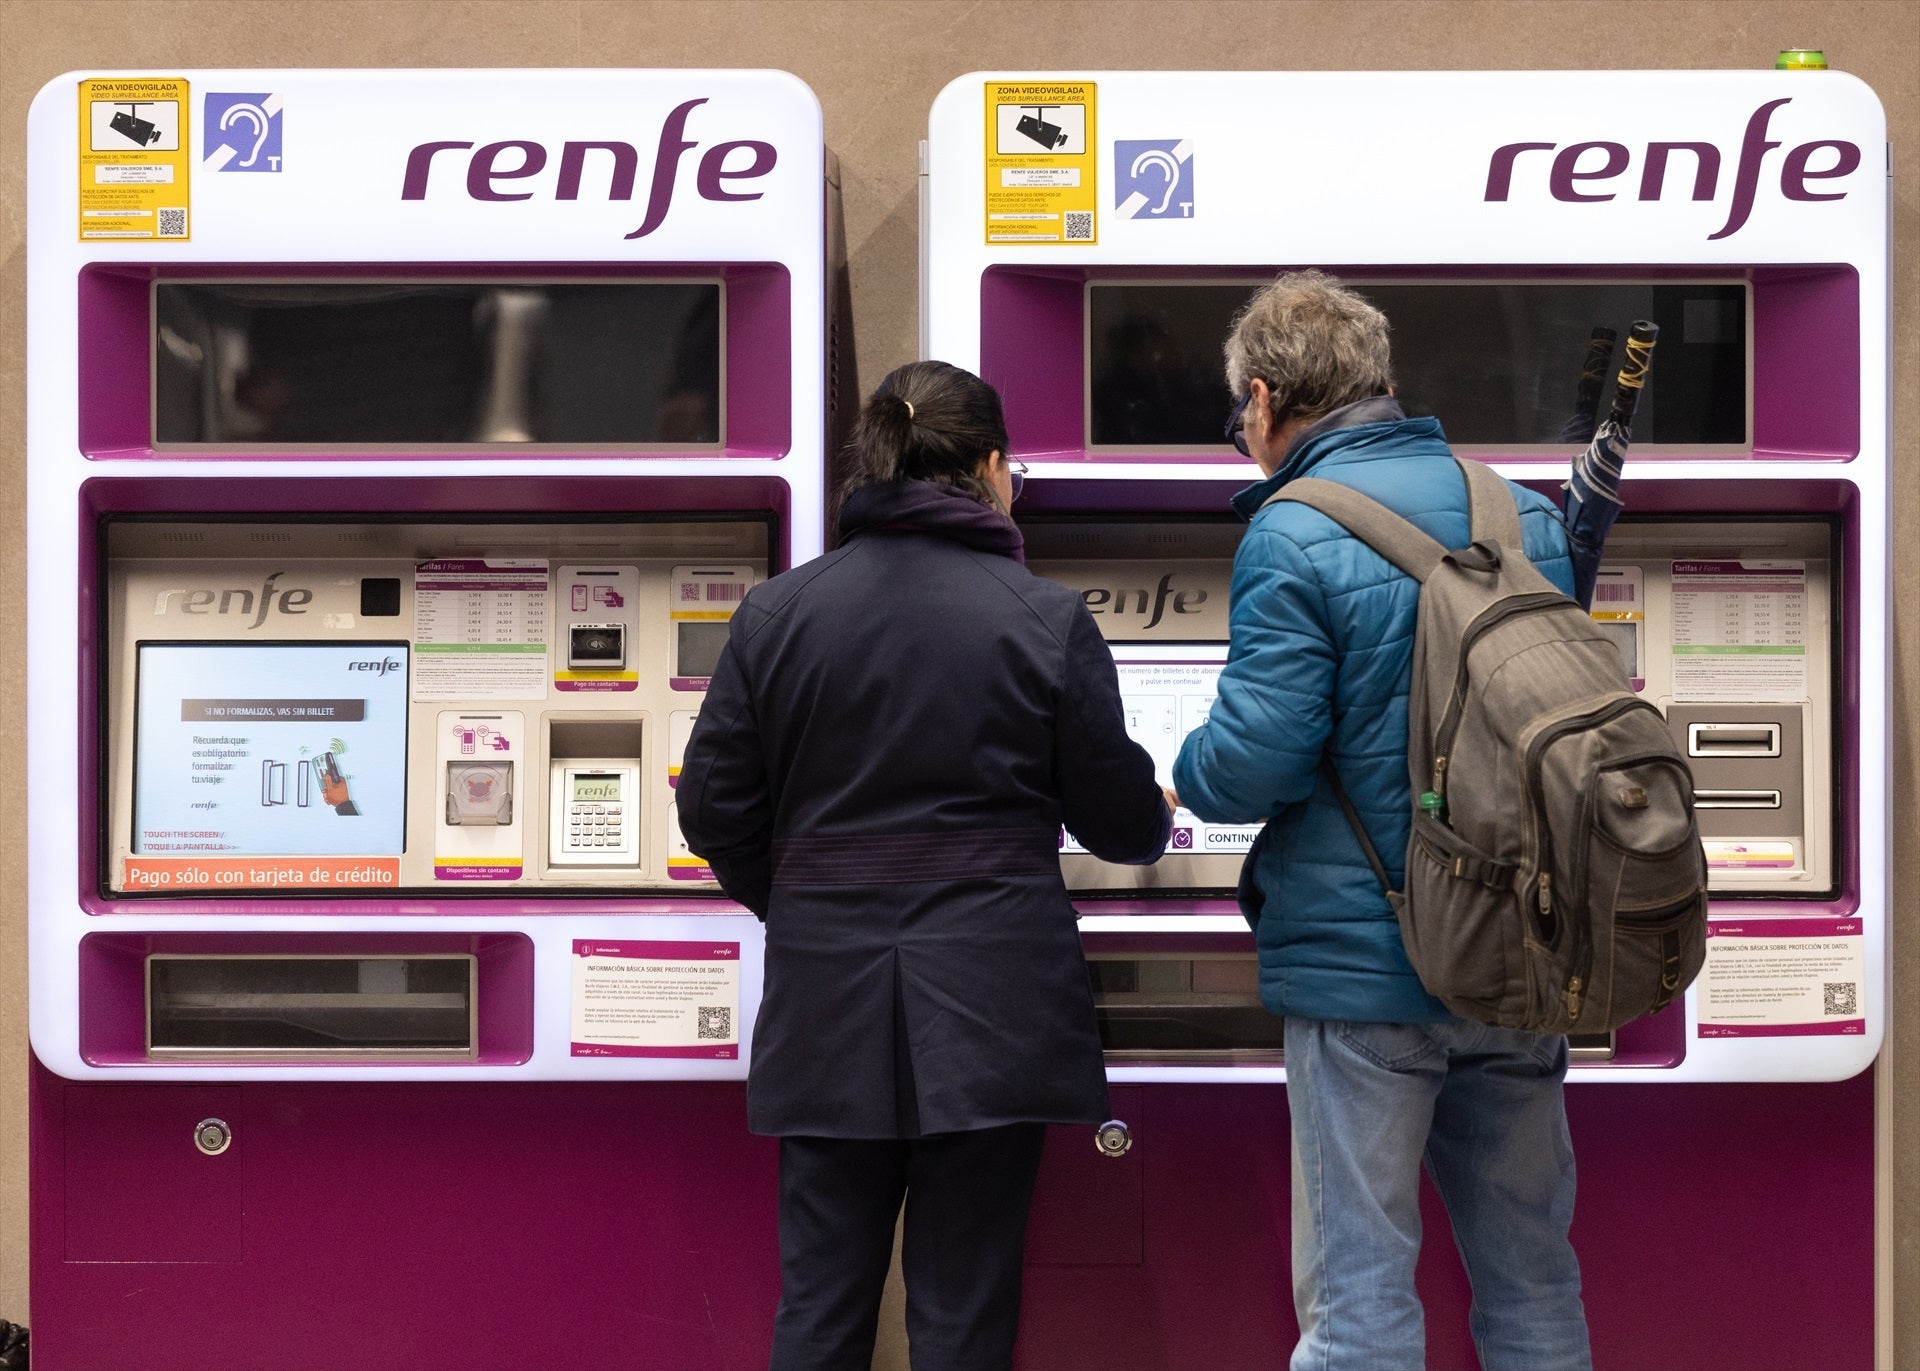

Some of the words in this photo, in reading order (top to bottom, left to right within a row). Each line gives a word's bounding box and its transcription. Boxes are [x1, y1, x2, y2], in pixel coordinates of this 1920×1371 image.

[268, 156, 281, 171] T
[401, 98, 778, 240] renfe
[1484, 98, 1861, 240] renfe
[1179, 202, 1192, 216] T
[154, 572, 313, 630] renfe
[1080, 572, 1208, 630] enfe
[348, 656, 399, 677] renfe
[205, 708, 211, 716] SI
[214, 708, 225, 716] NO
[227, 708, 275, 716] FORMALIZAS,
[277, 708, 291, 716] VAS
[292, 708, 305, 716] SIN
[307, 708, 334, 716] BILLETE
[1132, 717, 1137, 726] 1
[193, 736, 229, 745] Recuerda
[231, 737, 246, 747] que
[203, 748, 246, 759] obligatorio
[192, 761, 232, 771] formalizar
[202, 775, 222, 785] viaje
[577, 783, 617, 797] renfe
[191, 801, 216, 810] renfe
[1208, 834, 1256, 843] CONTINU
[130, 868, 170, 887] Pago
[176, 868, 209, 884] sólo
[215, 871, 244, 883] con
[250, 868, 303, 887] tarjeta
[307, 866, 330, 882] de
[336, 866, 392, 882] crédito
